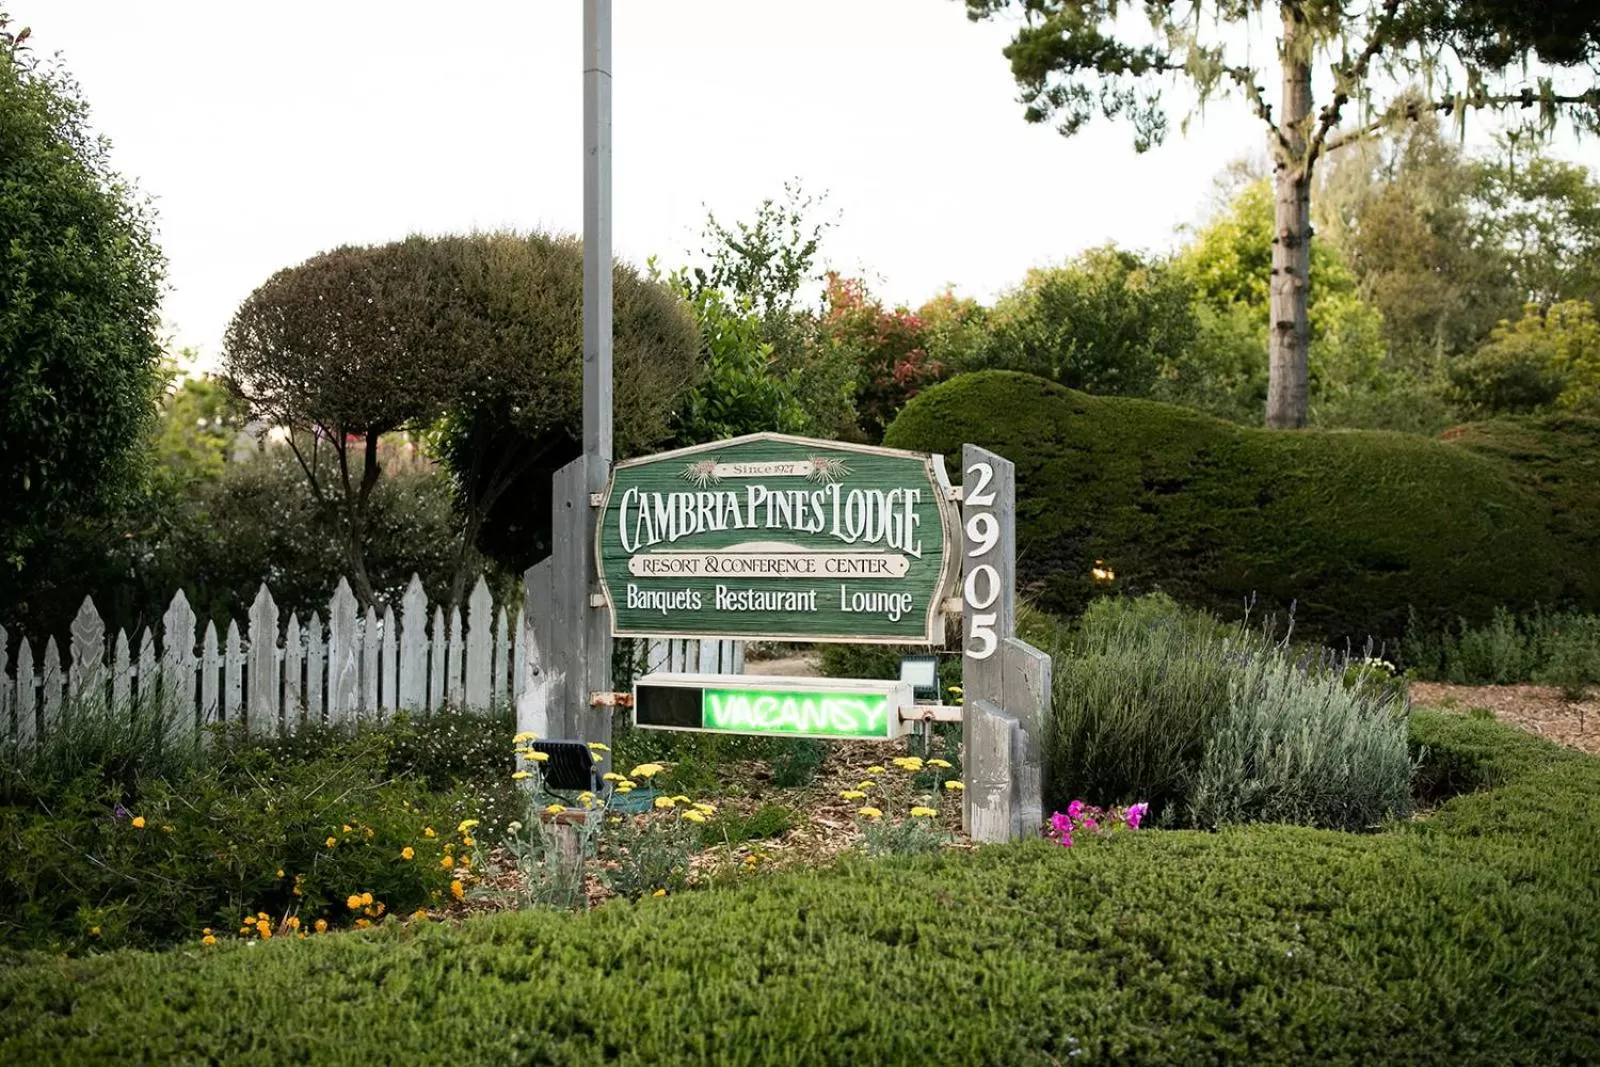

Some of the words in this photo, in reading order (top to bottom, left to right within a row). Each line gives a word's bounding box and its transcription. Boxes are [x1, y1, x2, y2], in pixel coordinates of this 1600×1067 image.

[733, 465, 771, 474] Since
[774, 464, 795, 474] 1927
[619, 485, 744, 553] CAMBRIA
[826, 483, 922, 559] LODGE
[643, 559, 700, 575] RESORT
[704, 556, 719, 573] &
[721, 559, 816, 575] CONFERENCE
[825, 559, 895, 575] CENTER
[964, 462, 1001, 660] 2905
[627, 583, 702, 615] Banquets
[715, 584, 817, 611] Restaurant
[841, 584, 913, 622] Lounge
